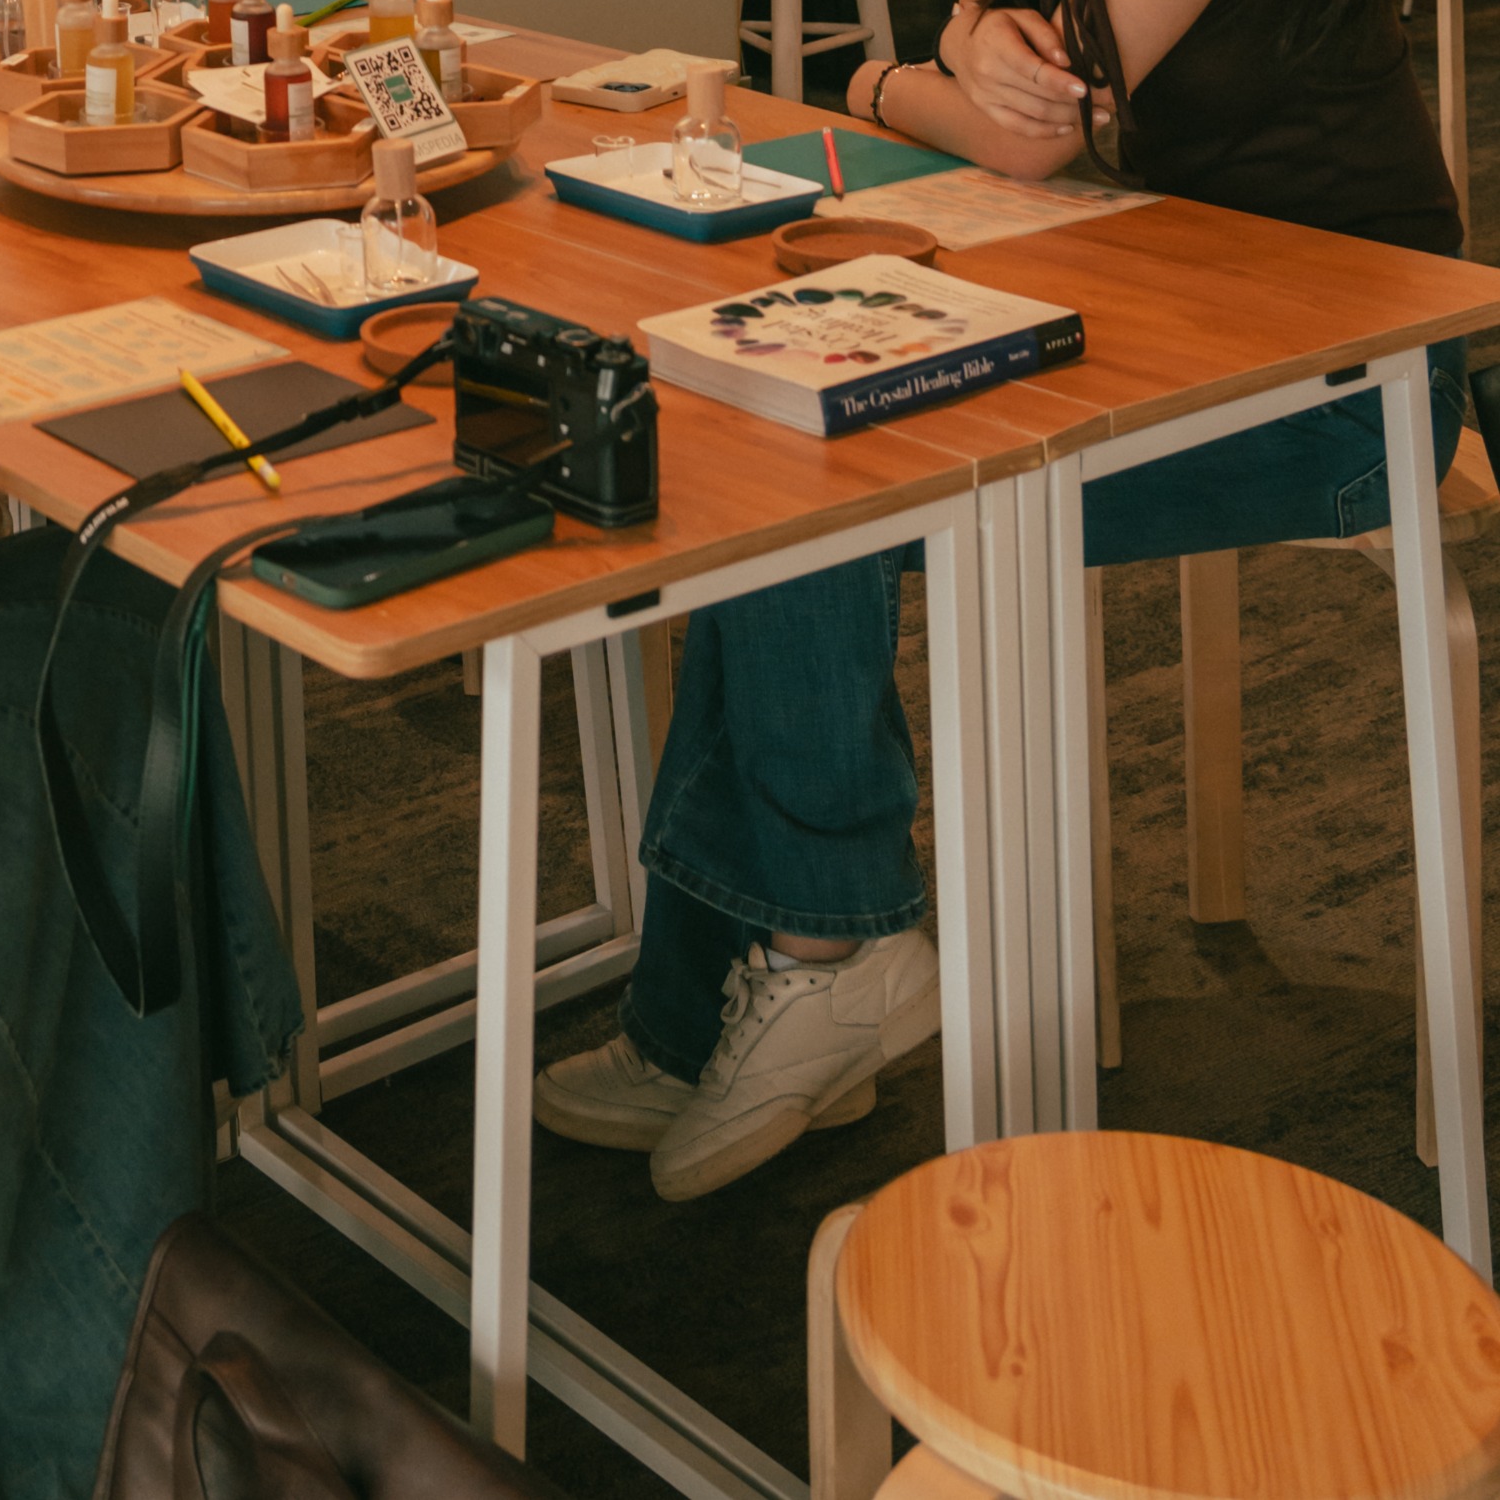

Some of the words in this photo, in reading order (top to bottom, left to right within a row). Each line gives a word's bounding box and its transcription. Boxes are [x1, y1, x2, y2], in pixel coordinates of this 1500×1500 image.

[1045, 336, 1073, 350] APPLE
[841, 397, 868, 417] The
[870, 380, 912, 410] Crystal
[914, 368, 962, 394] Healing
[963, 357, 995, 379] Bible
